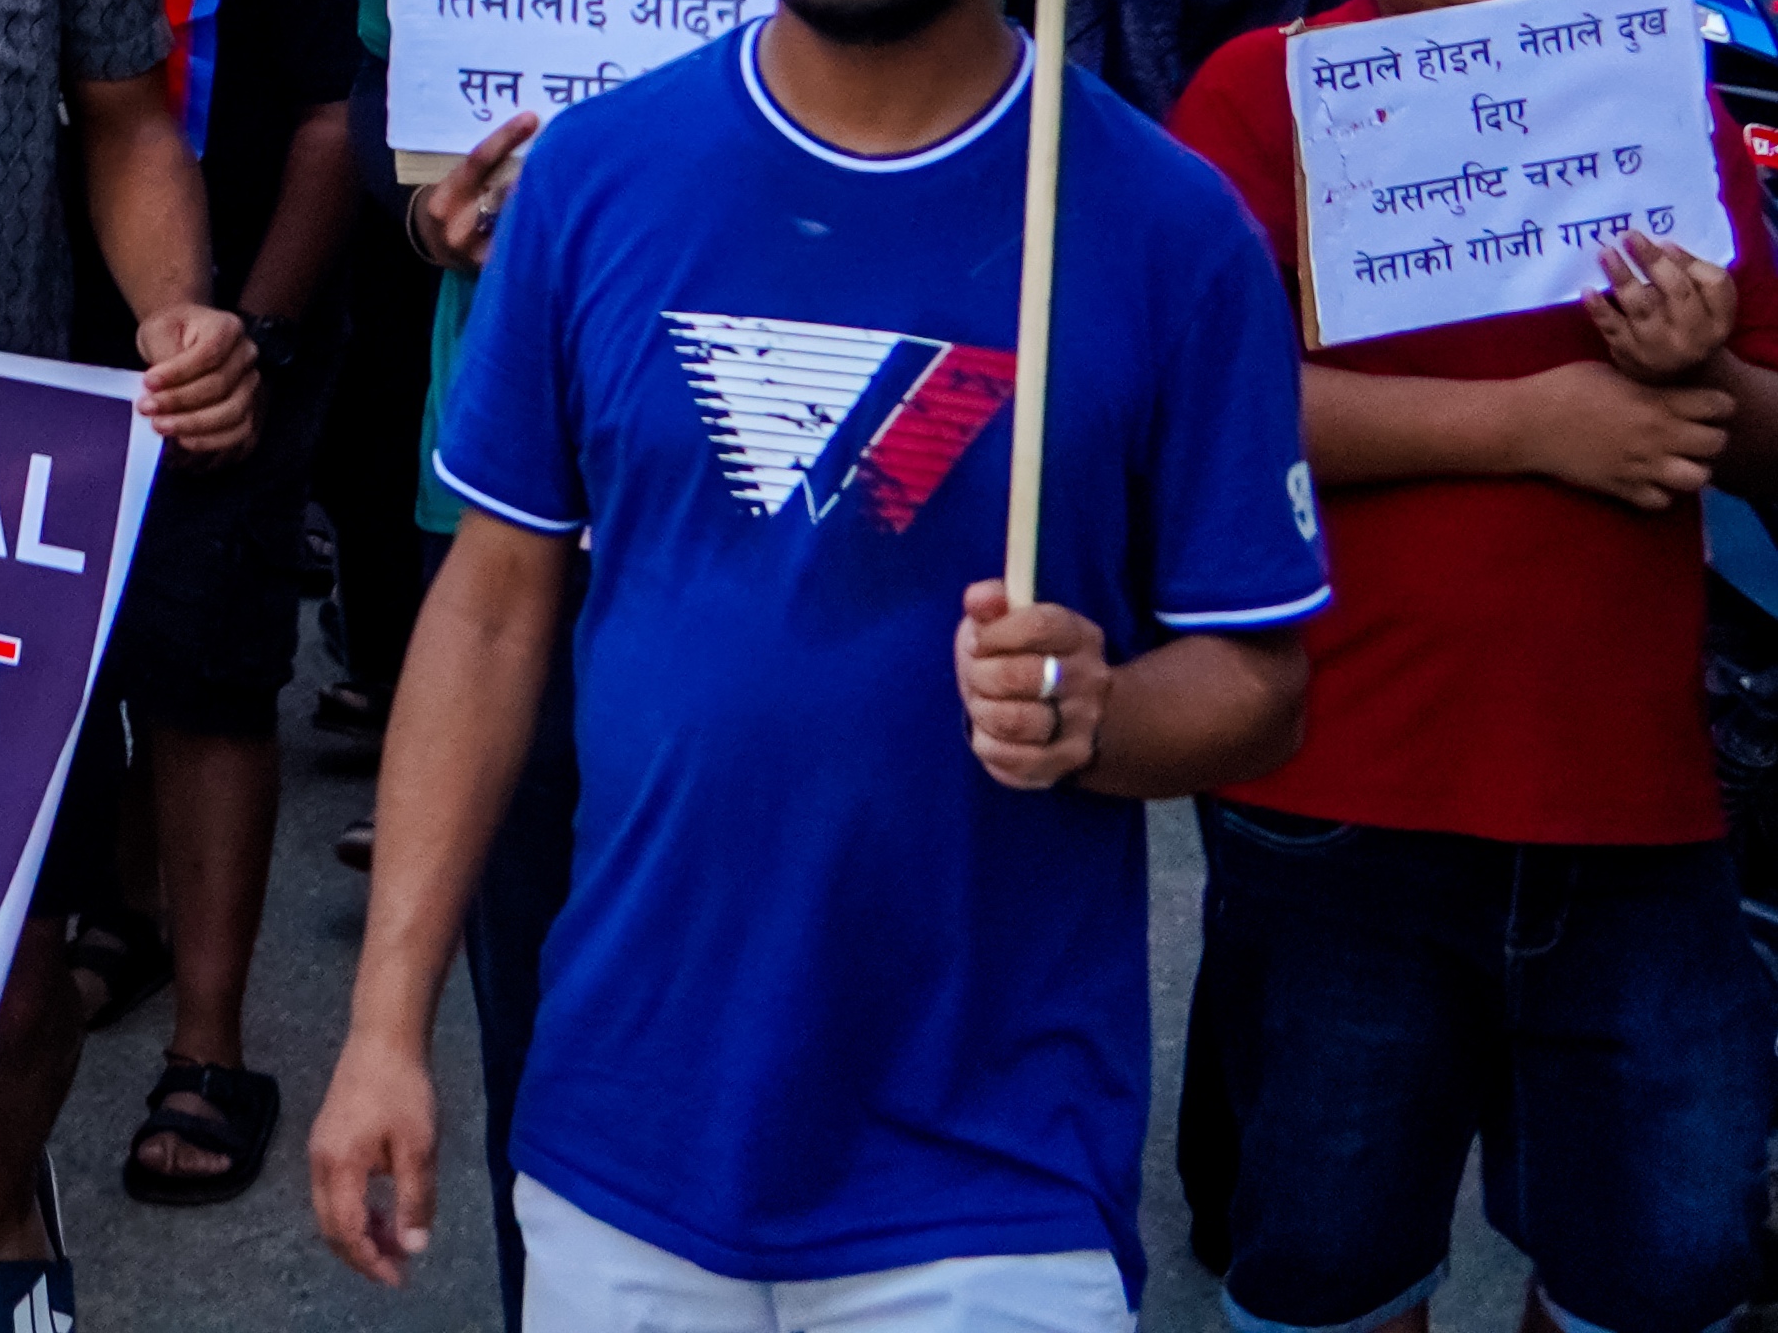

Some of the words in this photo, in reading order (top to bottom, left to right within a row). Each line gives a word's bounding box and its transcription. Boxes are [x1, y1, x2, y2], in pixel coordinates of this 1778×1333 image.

[1416, 36, 1502, 82] होइन,
[1518, 12, 1605, 59] नेताले
[1616, 7, 1670, 53] दुख
[457, 67, 525, 123] सुन
[1470, 93, 1529, 134] दिए
[1522, 149, 1600, 190] चरम
[1614, 144, 1644, 176] छ
[1354, 239, 1454, 287] नेताको
[1467, 219, 1544, 266] गोजी
[1559, 211, 1632, 250] गरम
[1646, 204, 1676, 236] छ
